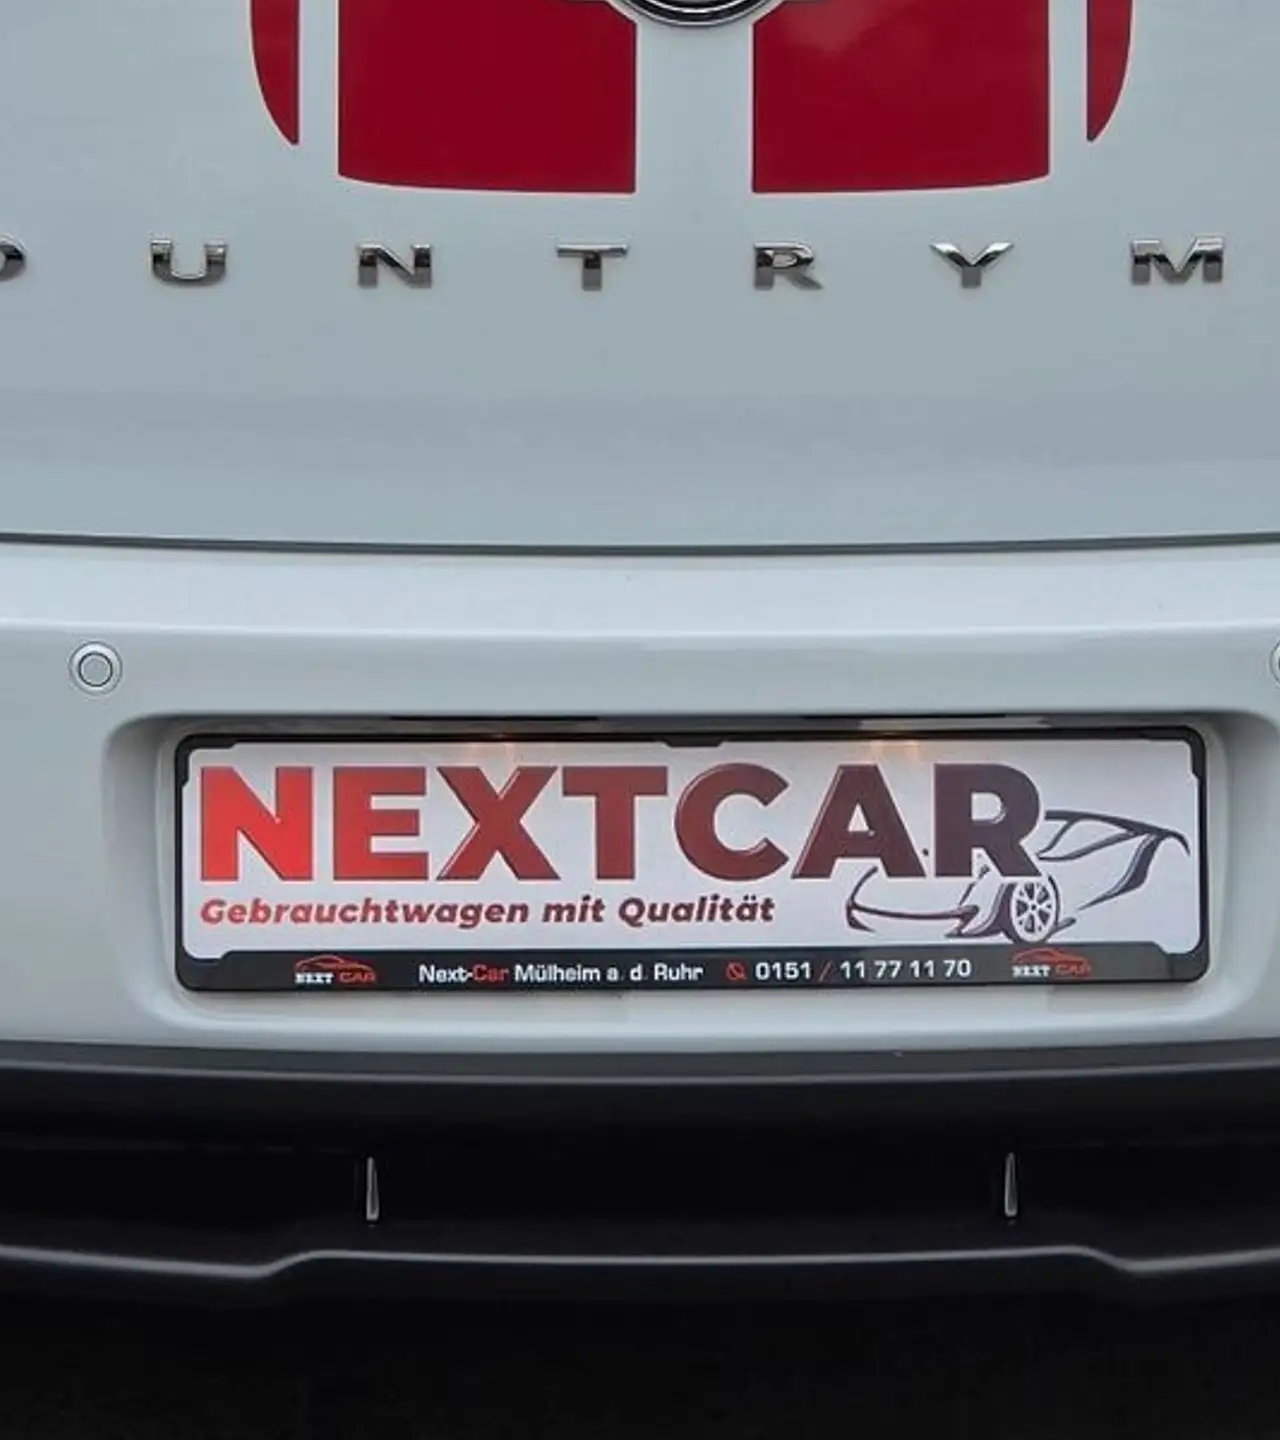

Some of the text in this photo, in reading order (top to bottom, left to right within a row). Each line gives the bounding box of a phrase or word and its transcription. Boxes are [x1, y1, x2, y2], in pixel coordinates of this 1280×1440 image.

[198, 762, 1042, 882] NEXTCAR
[199, 893, 776, 930] Gebrauchtwagen mit Qualität
[419, 964, 510, 984] Next-Car
[515, 964, 601, 982] Mülheim
[653, 963, 704, 981] Ruhr
[755, 962, 812, 981] 0151
[840, 962, 866, 980] 11
[873, 961, 902, 979] 77
[909, 960, 935, 978] 11
[943, 959, 971, 978] 70
